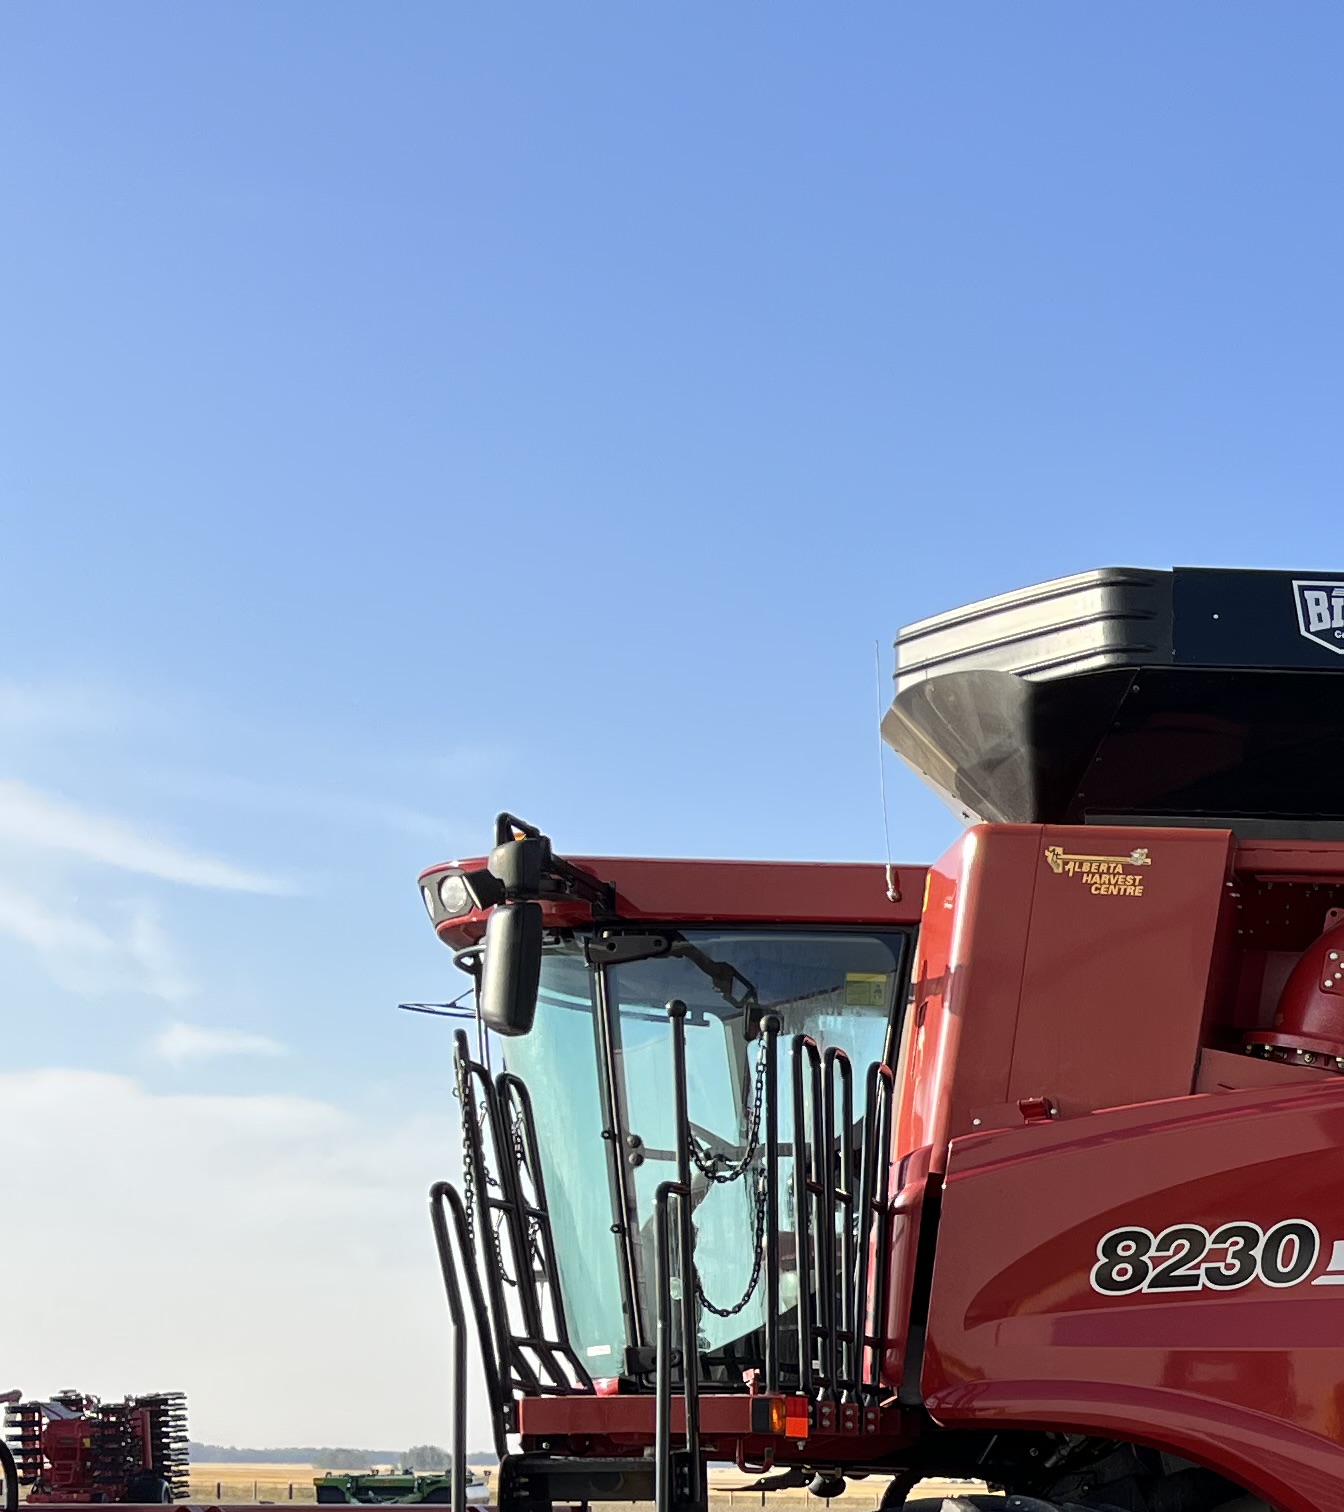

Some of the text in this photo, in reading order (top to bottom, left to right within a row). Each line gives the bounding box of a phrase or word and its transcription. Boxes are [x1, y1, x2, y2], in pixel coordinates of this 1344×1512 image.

[1065, 861, 1123, 877] ALBERTA
[1082, 874, 1143, 885] HARVEST
[1091, 885, 1144, 896] CENTRE
[1089, 1218, 1321, 1296] 8230
